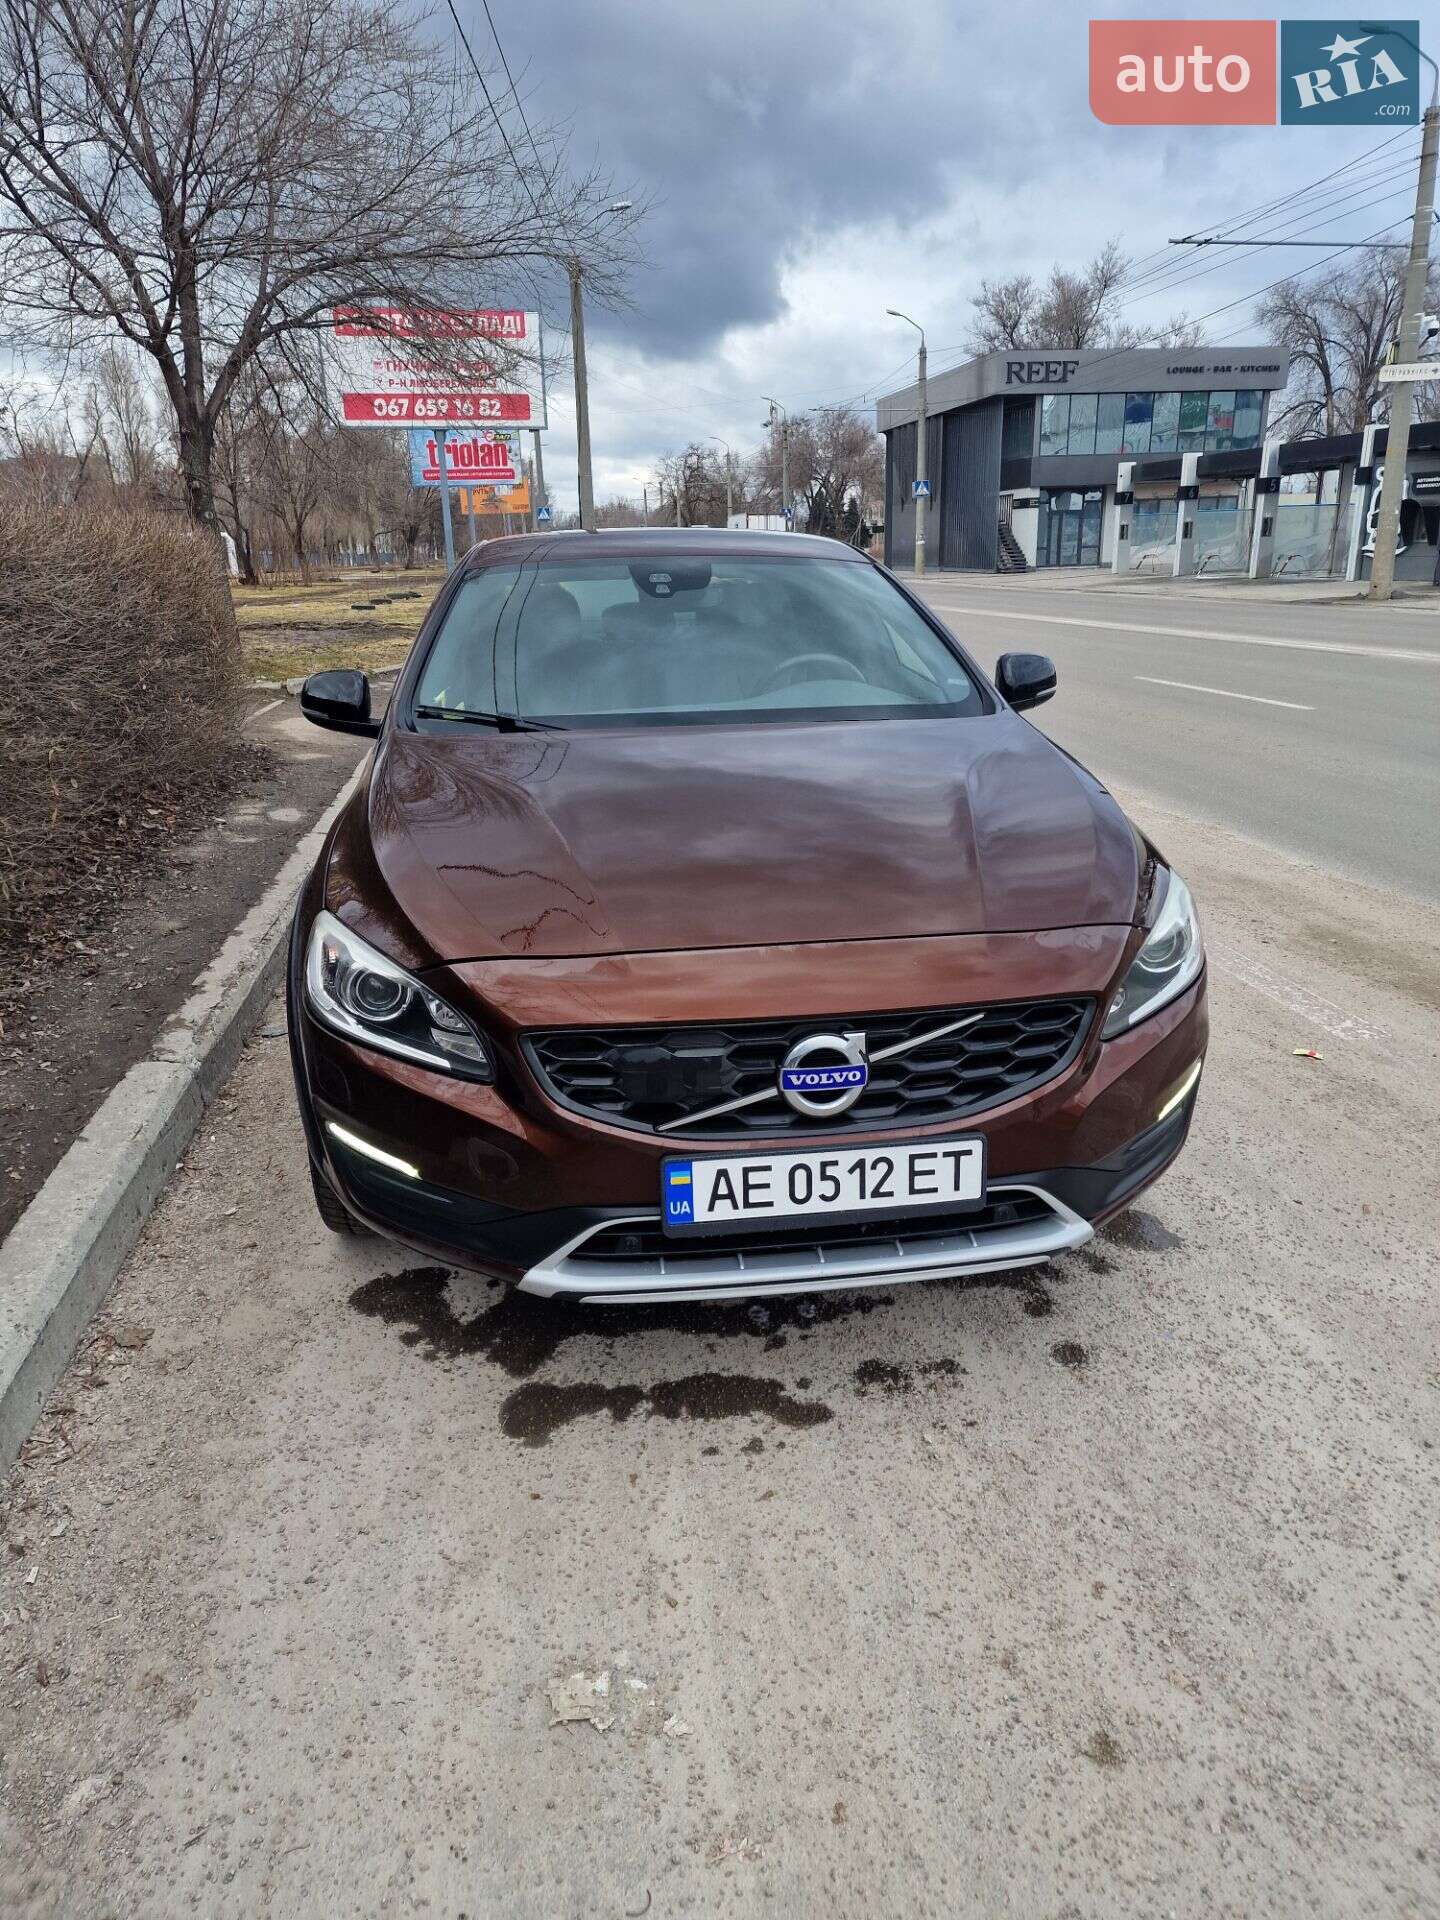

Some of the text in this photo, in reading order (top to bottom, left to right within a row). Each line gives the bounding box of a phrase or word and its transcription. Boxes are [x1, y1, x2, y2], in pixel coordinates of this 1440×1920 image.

[1005, 360, 1079, 384] REEF
[1166, 364, 1281, 374] LOUNGE BAR KITCHEN
[372, 398, 502, 417] 067 659 16 82
[1188, 487, 1195, 498] 6
[1269, 480, 1276, 491] 5
[787, 1069, 862, 1086] VOLVO
[707, 1149, 973, 1212] AE 0512 ET
[670, 1200, 691, 1215] UA
